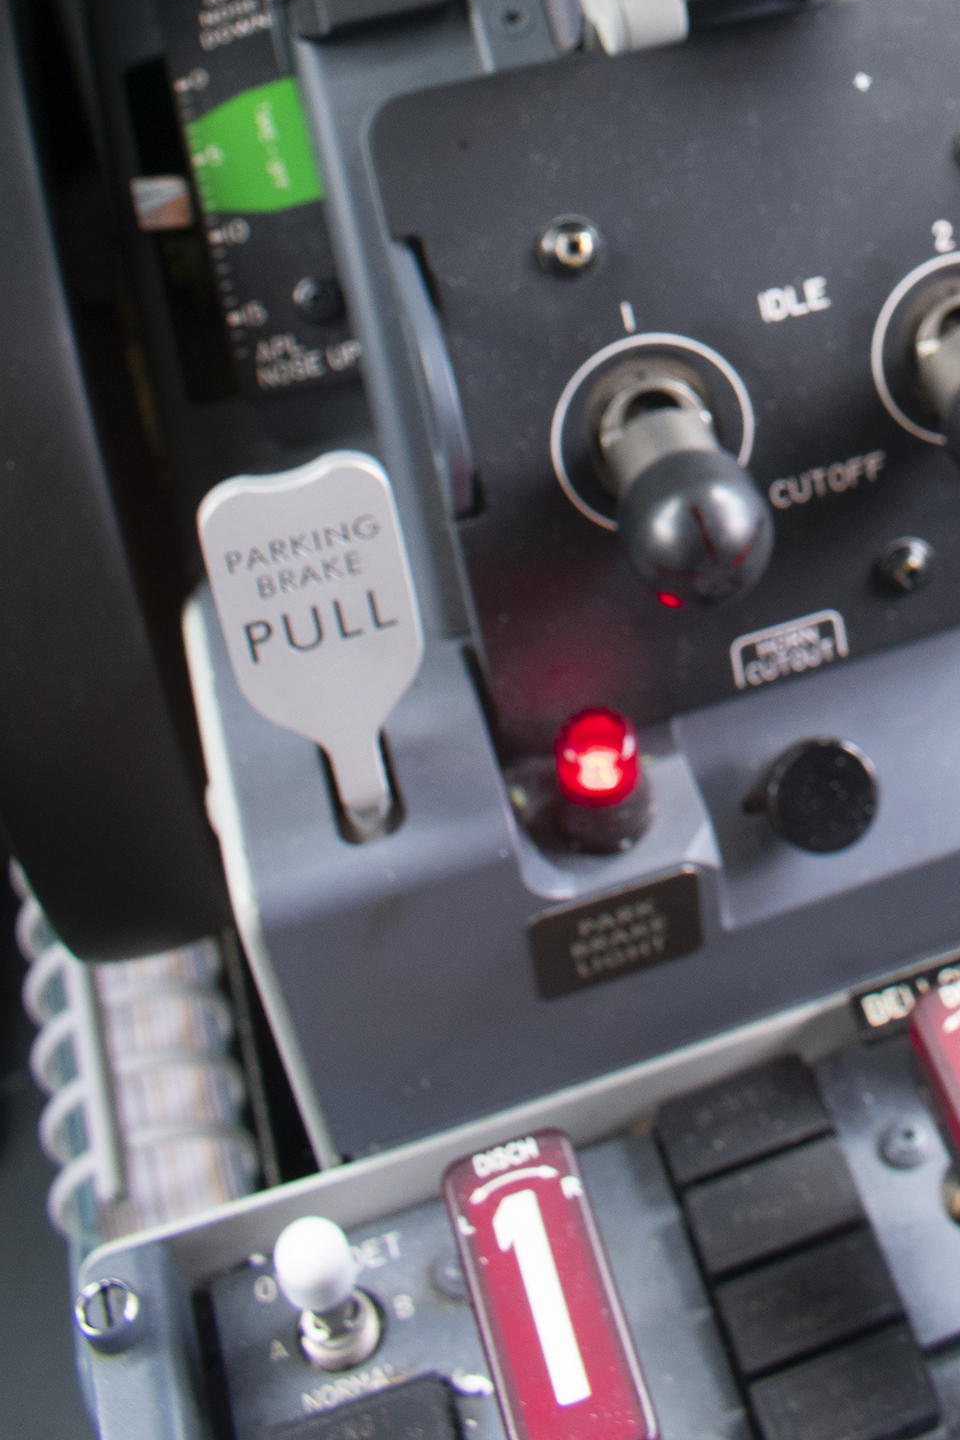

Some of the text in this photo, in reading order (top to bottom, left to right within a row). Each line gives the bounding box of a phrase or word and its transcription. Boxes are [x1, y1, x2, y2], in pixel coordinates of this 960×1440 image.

[931, 219, 957, 253] 2
[757, 265, 832, 324] IDLE
[325, 337, 364, 372] UP
[768, 449, 887, 510] CUTOFF
[223, 512, 383, 577] PARKING
[256, 547, 364, 601] BRAKE
[242, 586, 400, 666] PULL
[491, 1188, 593, 1408] 1
